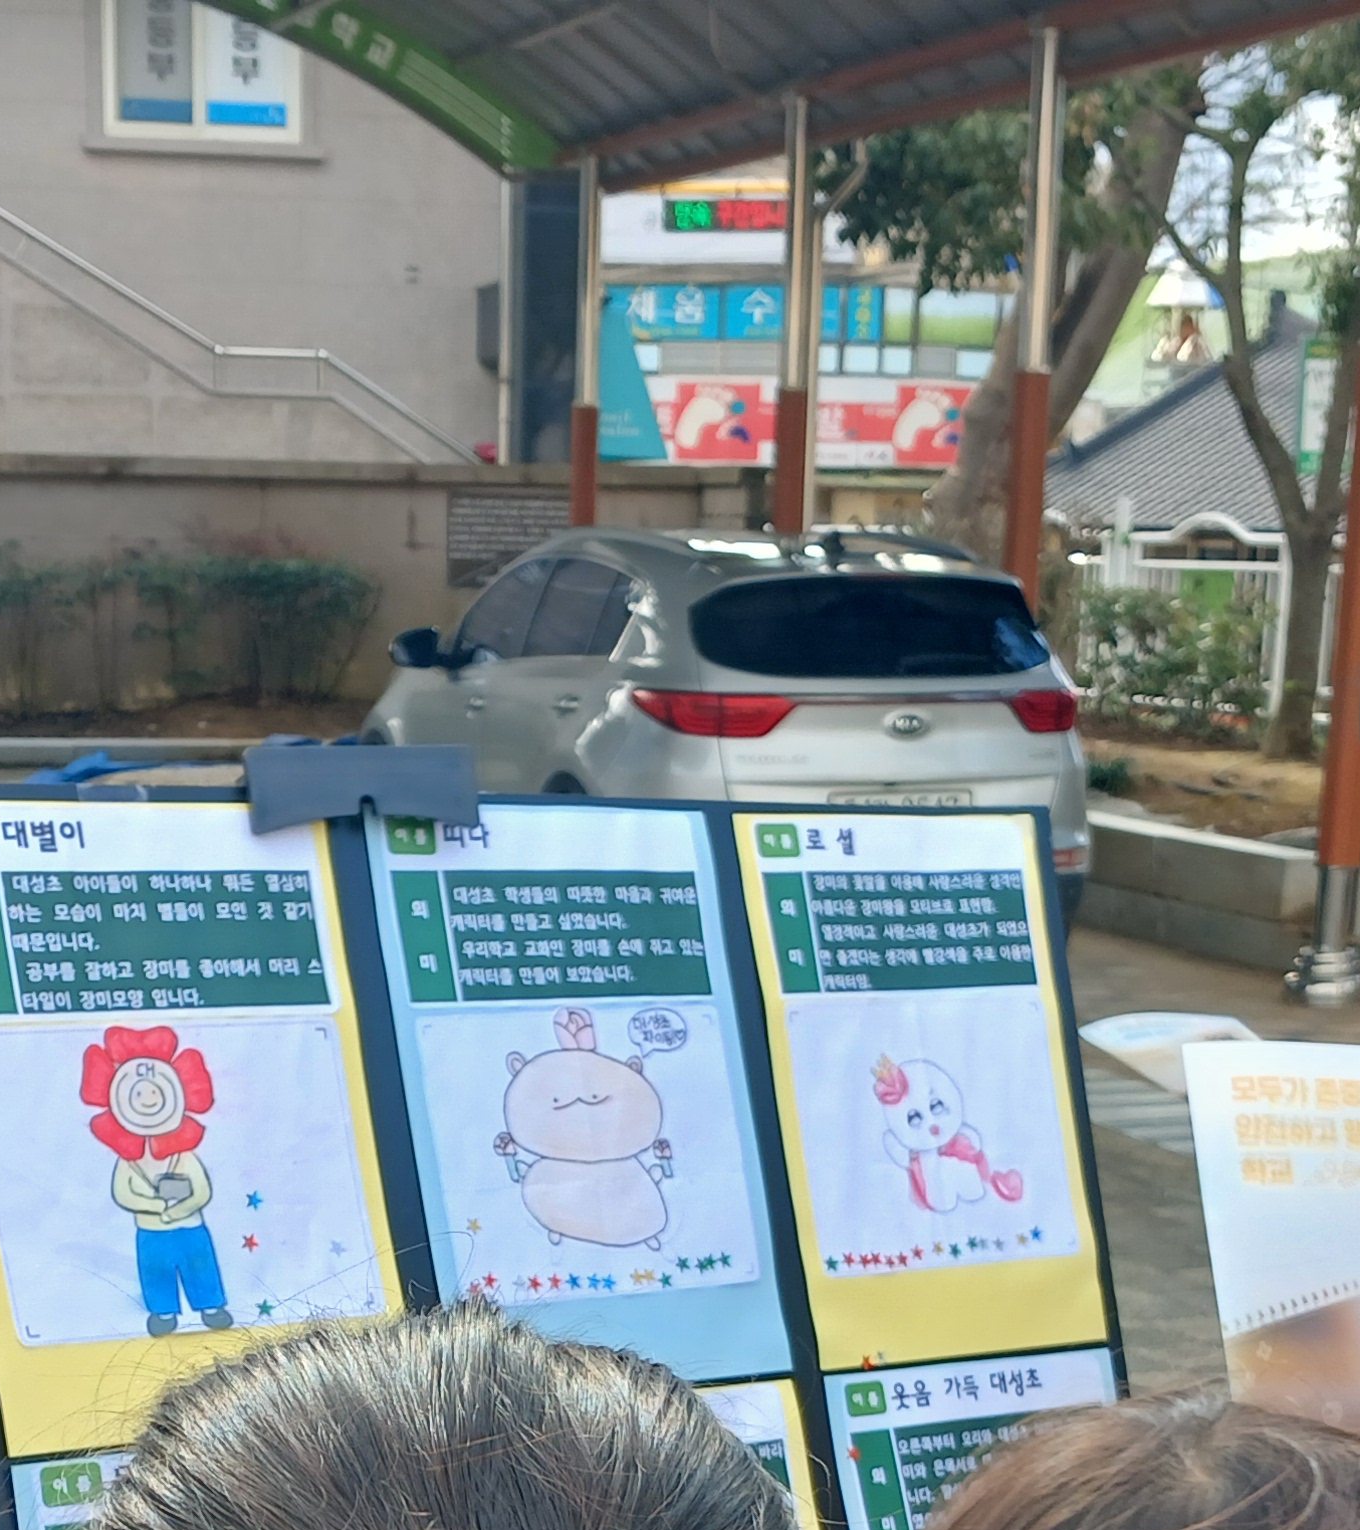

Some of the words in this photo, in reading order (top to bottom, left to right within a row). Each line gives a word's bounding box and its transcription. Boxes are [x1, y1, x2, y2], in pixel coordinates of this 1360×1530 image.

[1, 820, 85, 852] 대별이
[12, 875, 63, 894] 대성초
[73, 875, 138, 893] 아이들이
[149, 874, 212, 892] 하나하나
[264, 874, 308, 892] 열심히
[453, 886, 497, 905] 대성초
[502, 886, 559, 904] 학생들의
[567, 886, 607, 904] 따뜻한
[8, 904, 42, 922] 하는
[54, 903, 101, 922] 모습이
[113, 902, 146, 922] 마치
[157, 902, 205, 921] 별들이
[216, 902, 248, 921] 모인
[257, 902, 274, 920] 것
[283, 902, 313, 920] 같기
[450, 914, 505, 932] 캐릭터를
[511, 913, 553, 931] 만들고
[11, 932, 100, 952] 때문입니다.
[462, 941, 518, 959] 우리학교
[571, 939, 611, 957] 장미를
[25, 961, 75, 982] 공부를
[84, 961, 134, 981] 잘하고
[142, 959, 190, 980] 장미를
[199, 958, 261, 978] 좋아해서
[269, 958, 300, 977] 머리
[458, 968, 514, 986] 캐릭터를
[519, 966, 560, 986] 만들어
[22, 991, 72, 1011] 타일이
[79, 989, 144, 1009] 장미모양
[151, 987, 205, 1006] 입니다.
[891, 1380, 931, 1411] 웃음
[944, 1374, 980, 1401] 가득
[990, 1367, 1043, 1396] 대성초
